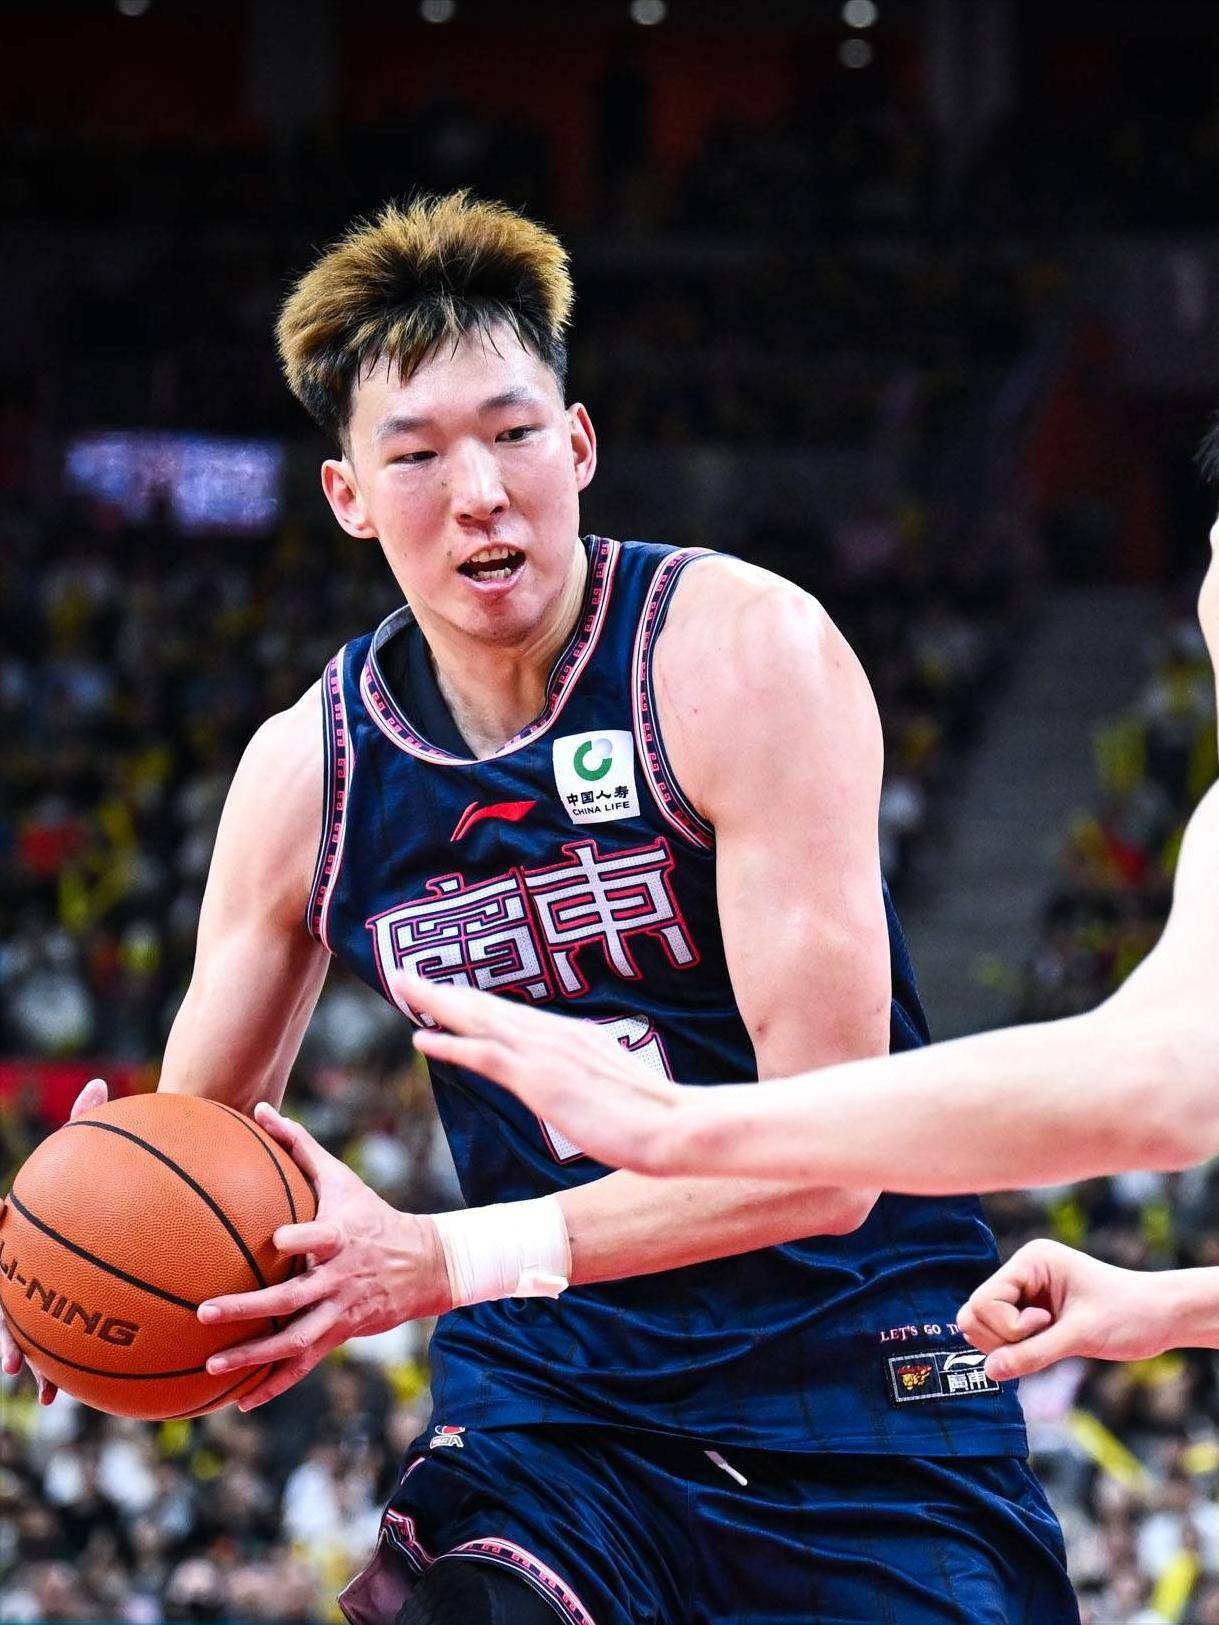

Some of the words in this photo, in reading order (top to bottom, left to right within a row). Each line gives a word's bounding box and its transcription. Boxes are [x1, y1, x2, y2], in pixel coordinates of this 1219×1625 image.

[567, 786, 629, 806] 中国人寿
[572, 806, 602, 816] CHINA
[605, 801, 631, 811] LIFE
[880, 1325, 918, 1342] LET'S
[924, 1324, 941, 1335] GO
